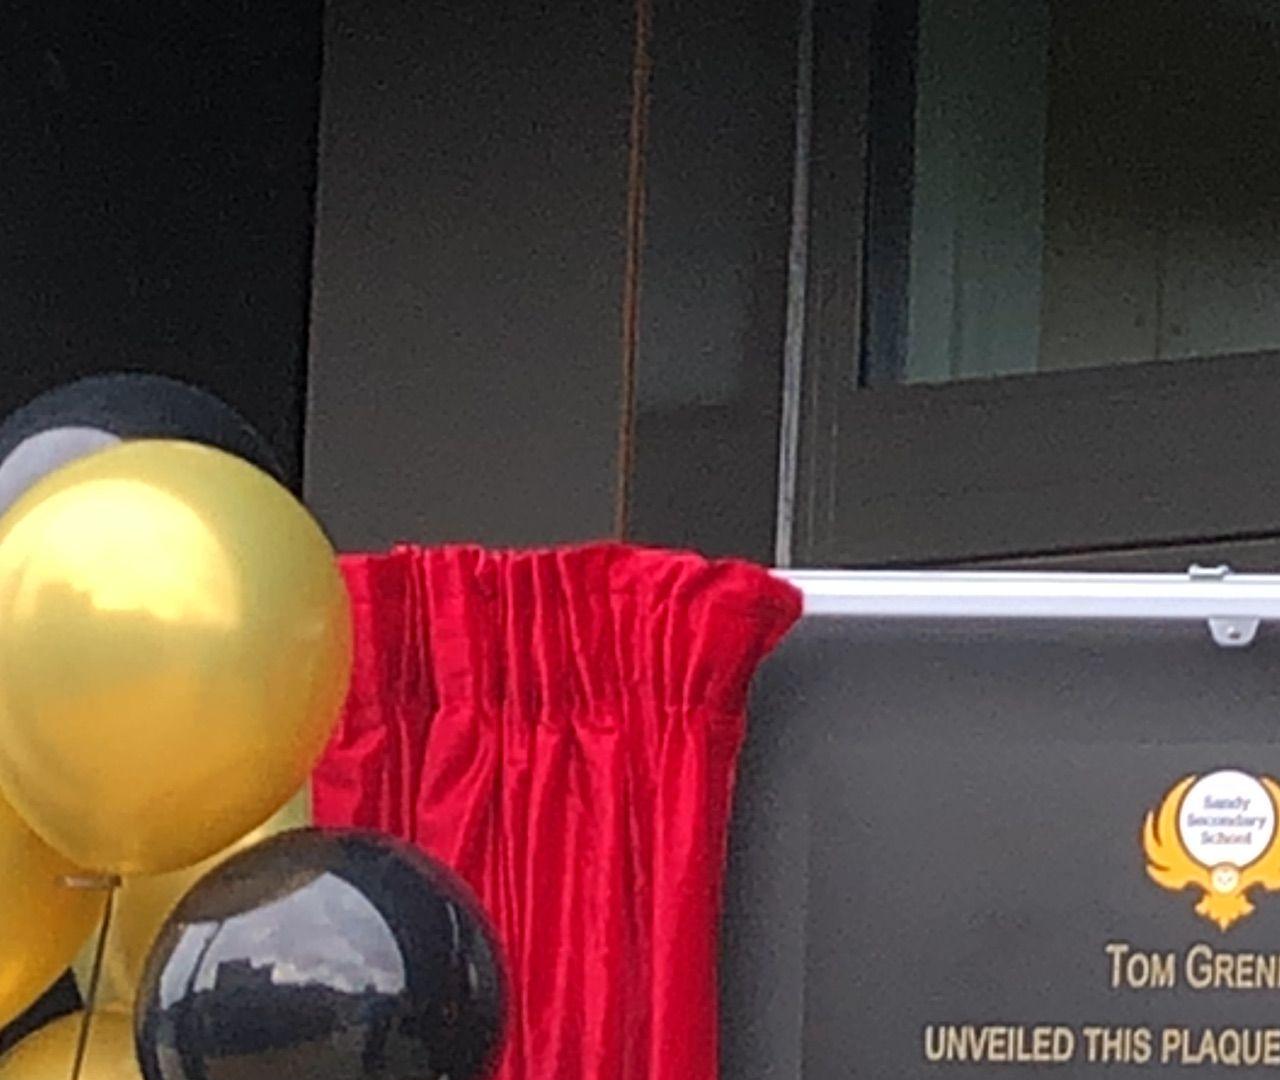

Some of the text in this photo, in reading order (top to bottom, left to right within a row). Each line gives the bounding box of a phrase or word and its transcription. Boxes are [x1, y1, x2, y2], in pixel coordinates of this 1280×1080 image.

[1104, 943, 1176, 989] TOM
[924, 1025, 1074, 1062] UNVEILED
[1083, 1027, 1152, 1064] THIS
